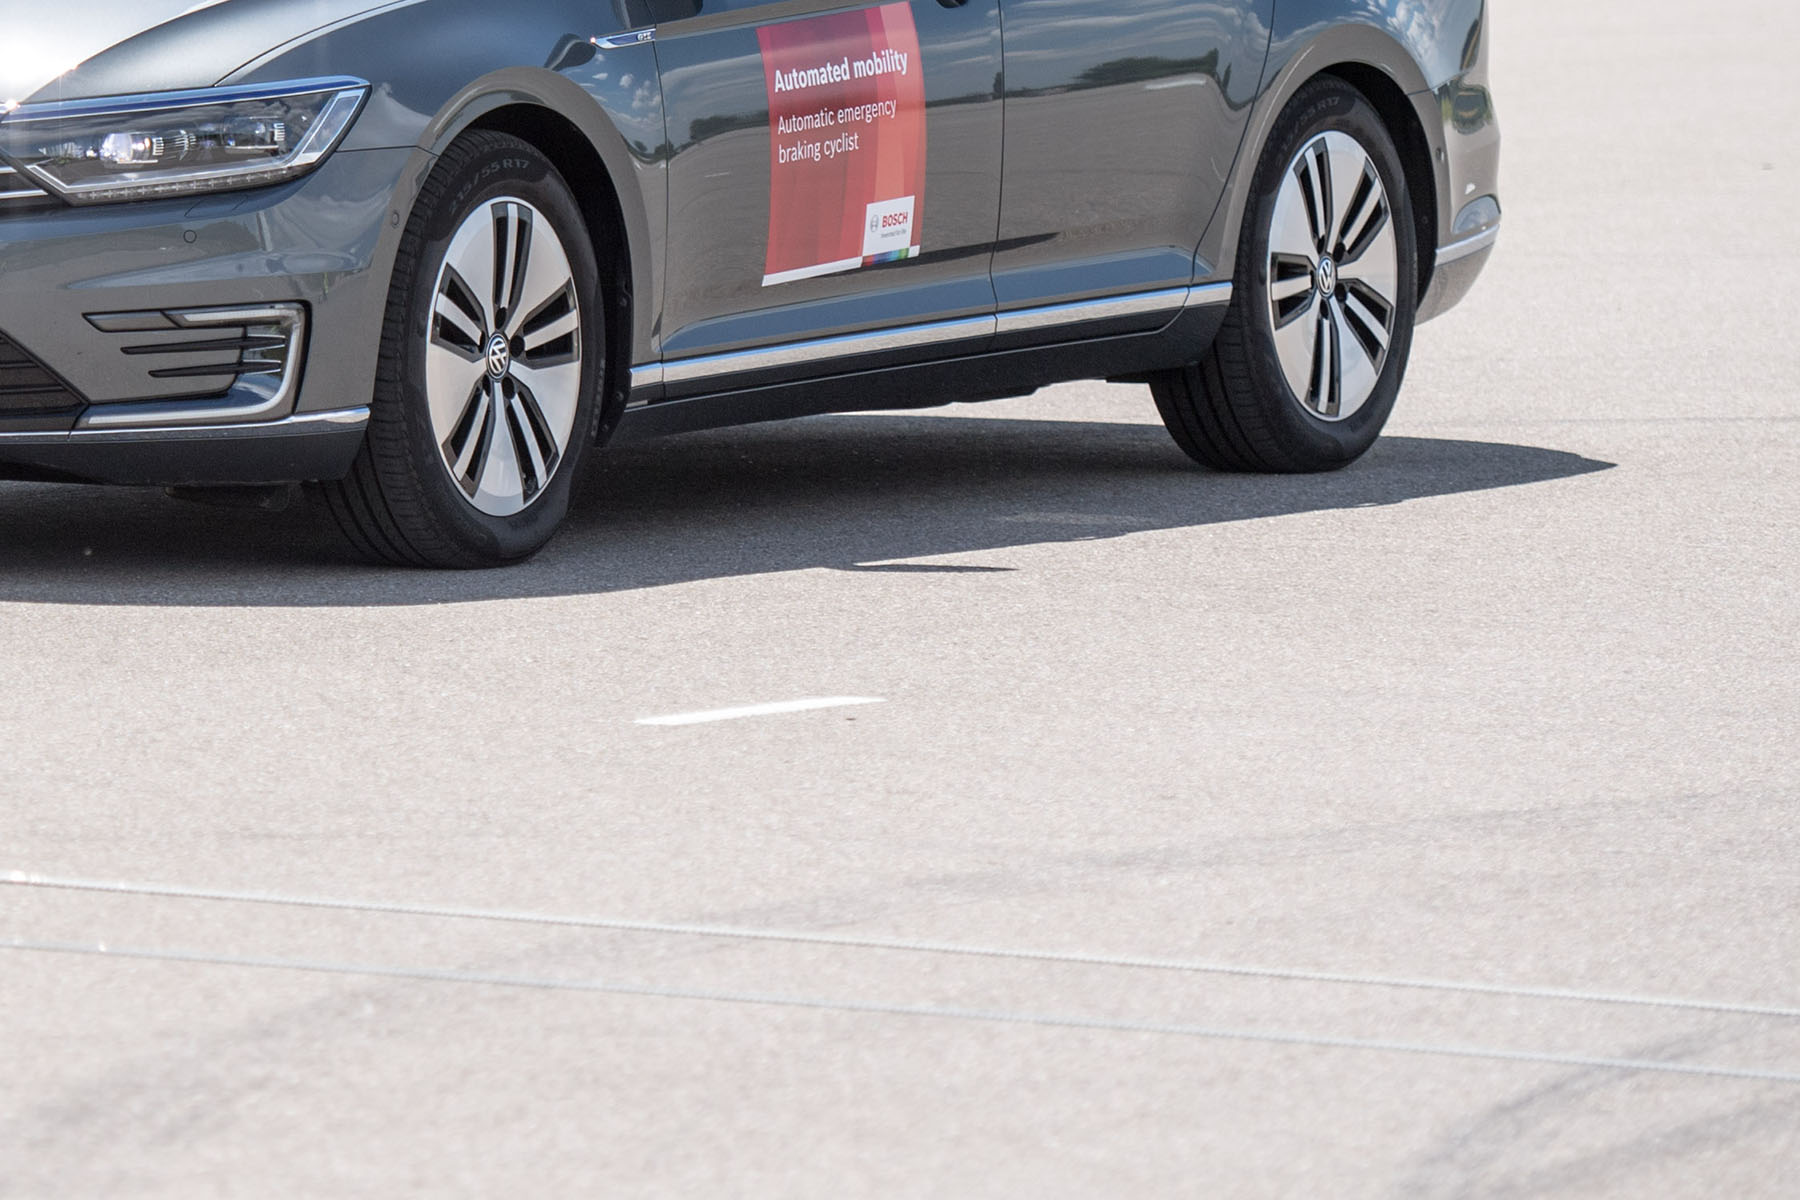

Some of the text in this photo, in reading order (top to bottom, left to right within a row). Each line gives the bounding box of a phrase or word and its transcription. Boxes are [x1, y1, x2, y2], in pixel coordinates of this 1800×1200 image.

[774, 48, 908, 93] Automated mobility
[777, 99, 896, 135] Automatic emergency
[778, 132, 859, 164] braking cyclist
[882, 211, 909, 228] BOSCH
